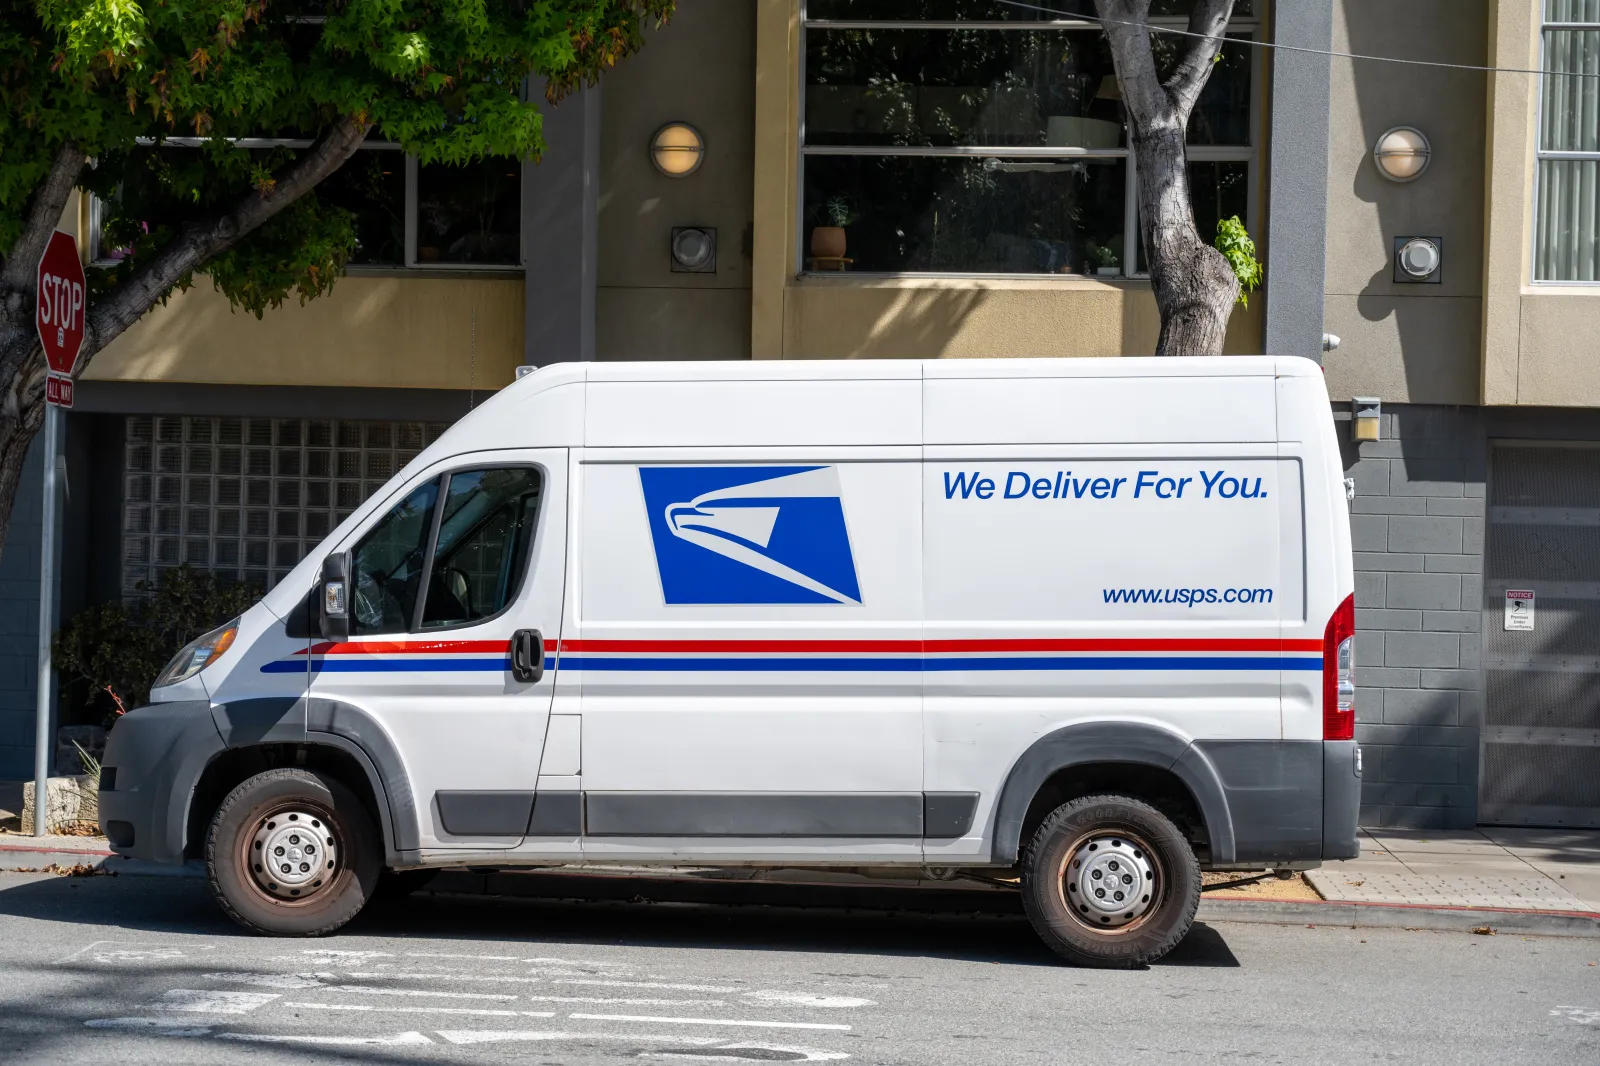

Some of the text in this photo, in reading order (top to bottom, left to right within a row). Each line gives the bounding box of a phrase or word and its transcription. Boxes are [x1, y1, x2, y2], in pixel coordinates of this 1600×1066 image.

[41, 273, 82, 331] STOP
[48, 381, 72, 401] ALL WAY
[943, 470, 1268, 500] We Deliver For You.
[1103, 588, 1274, 607] www.usps.com
